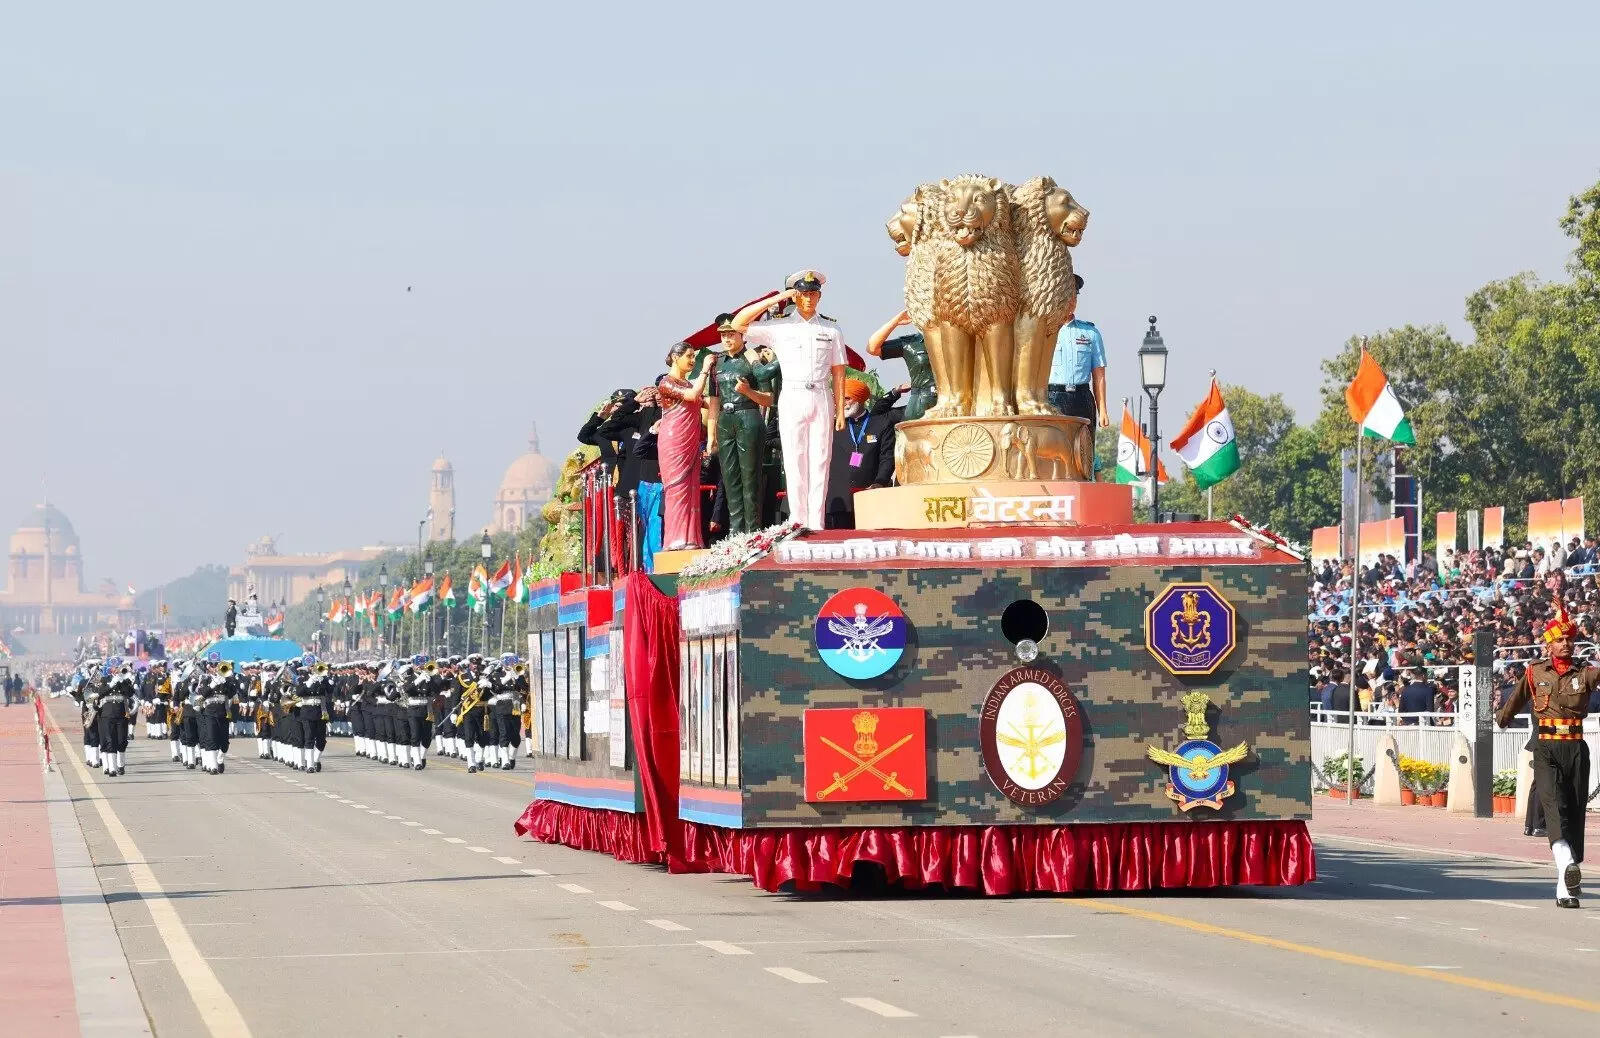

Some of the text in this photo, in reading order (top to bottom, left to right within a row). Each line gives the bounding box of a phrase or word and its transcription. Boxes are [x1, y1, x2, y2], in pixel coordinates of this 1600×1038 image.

[923, 487, 1075, 523] सत्य वेटरन्स
[984, 670, 1077, 721] INDIAN ARMED FORCES
[1002, 778, 1067, 803] VETERAN
